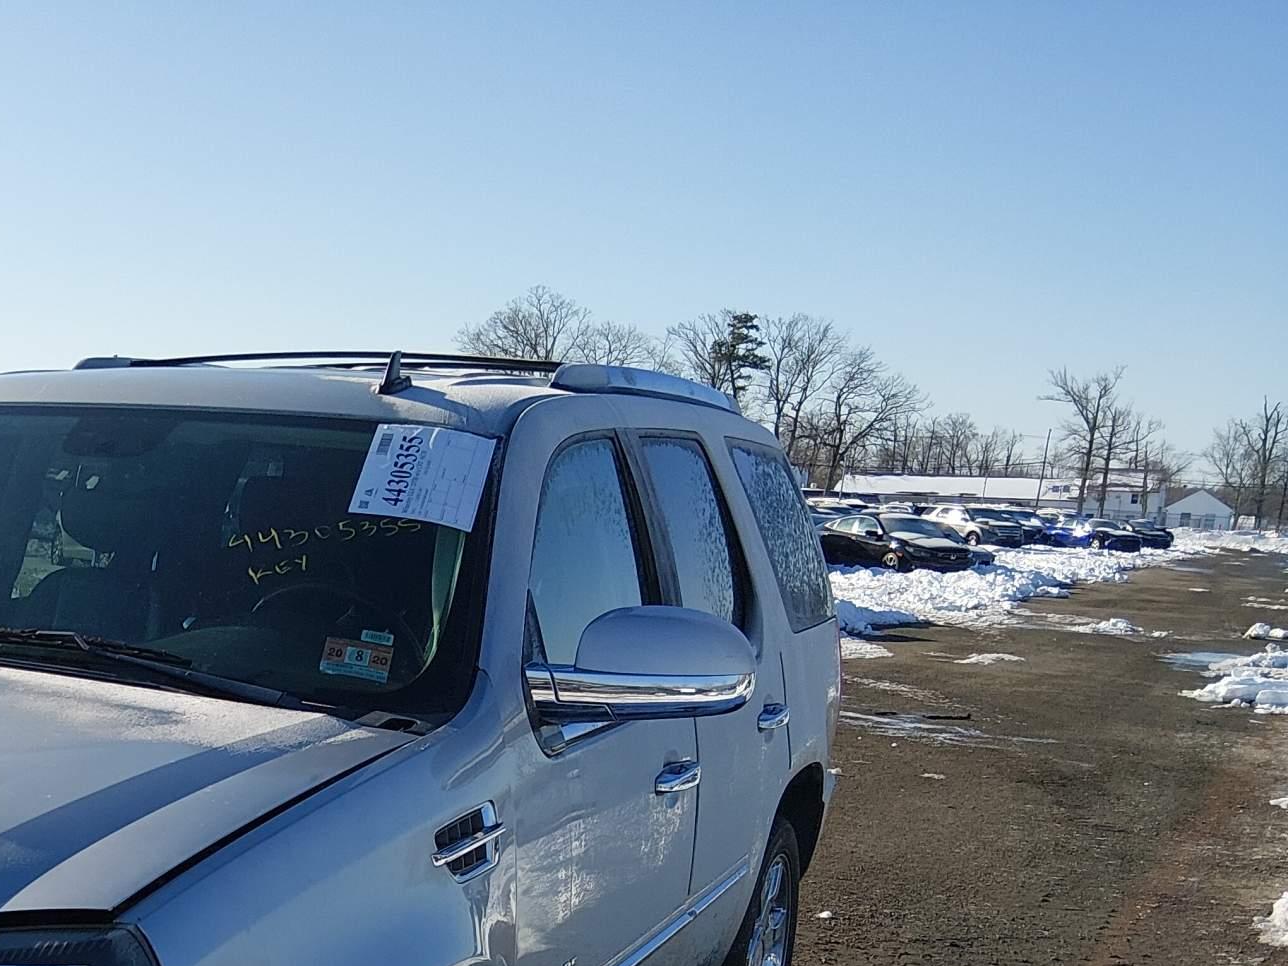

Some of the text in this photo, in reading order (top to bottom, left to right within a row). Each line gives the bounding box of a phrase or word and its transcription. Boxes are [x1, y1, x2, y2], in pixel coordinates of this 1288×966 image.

[382, 436, 424, 507] 44305355
[229, 518, 421, 552] 44305355
[248, 555, 307, 584] KEY
[328, 647, 388, 666] 20 8 20
